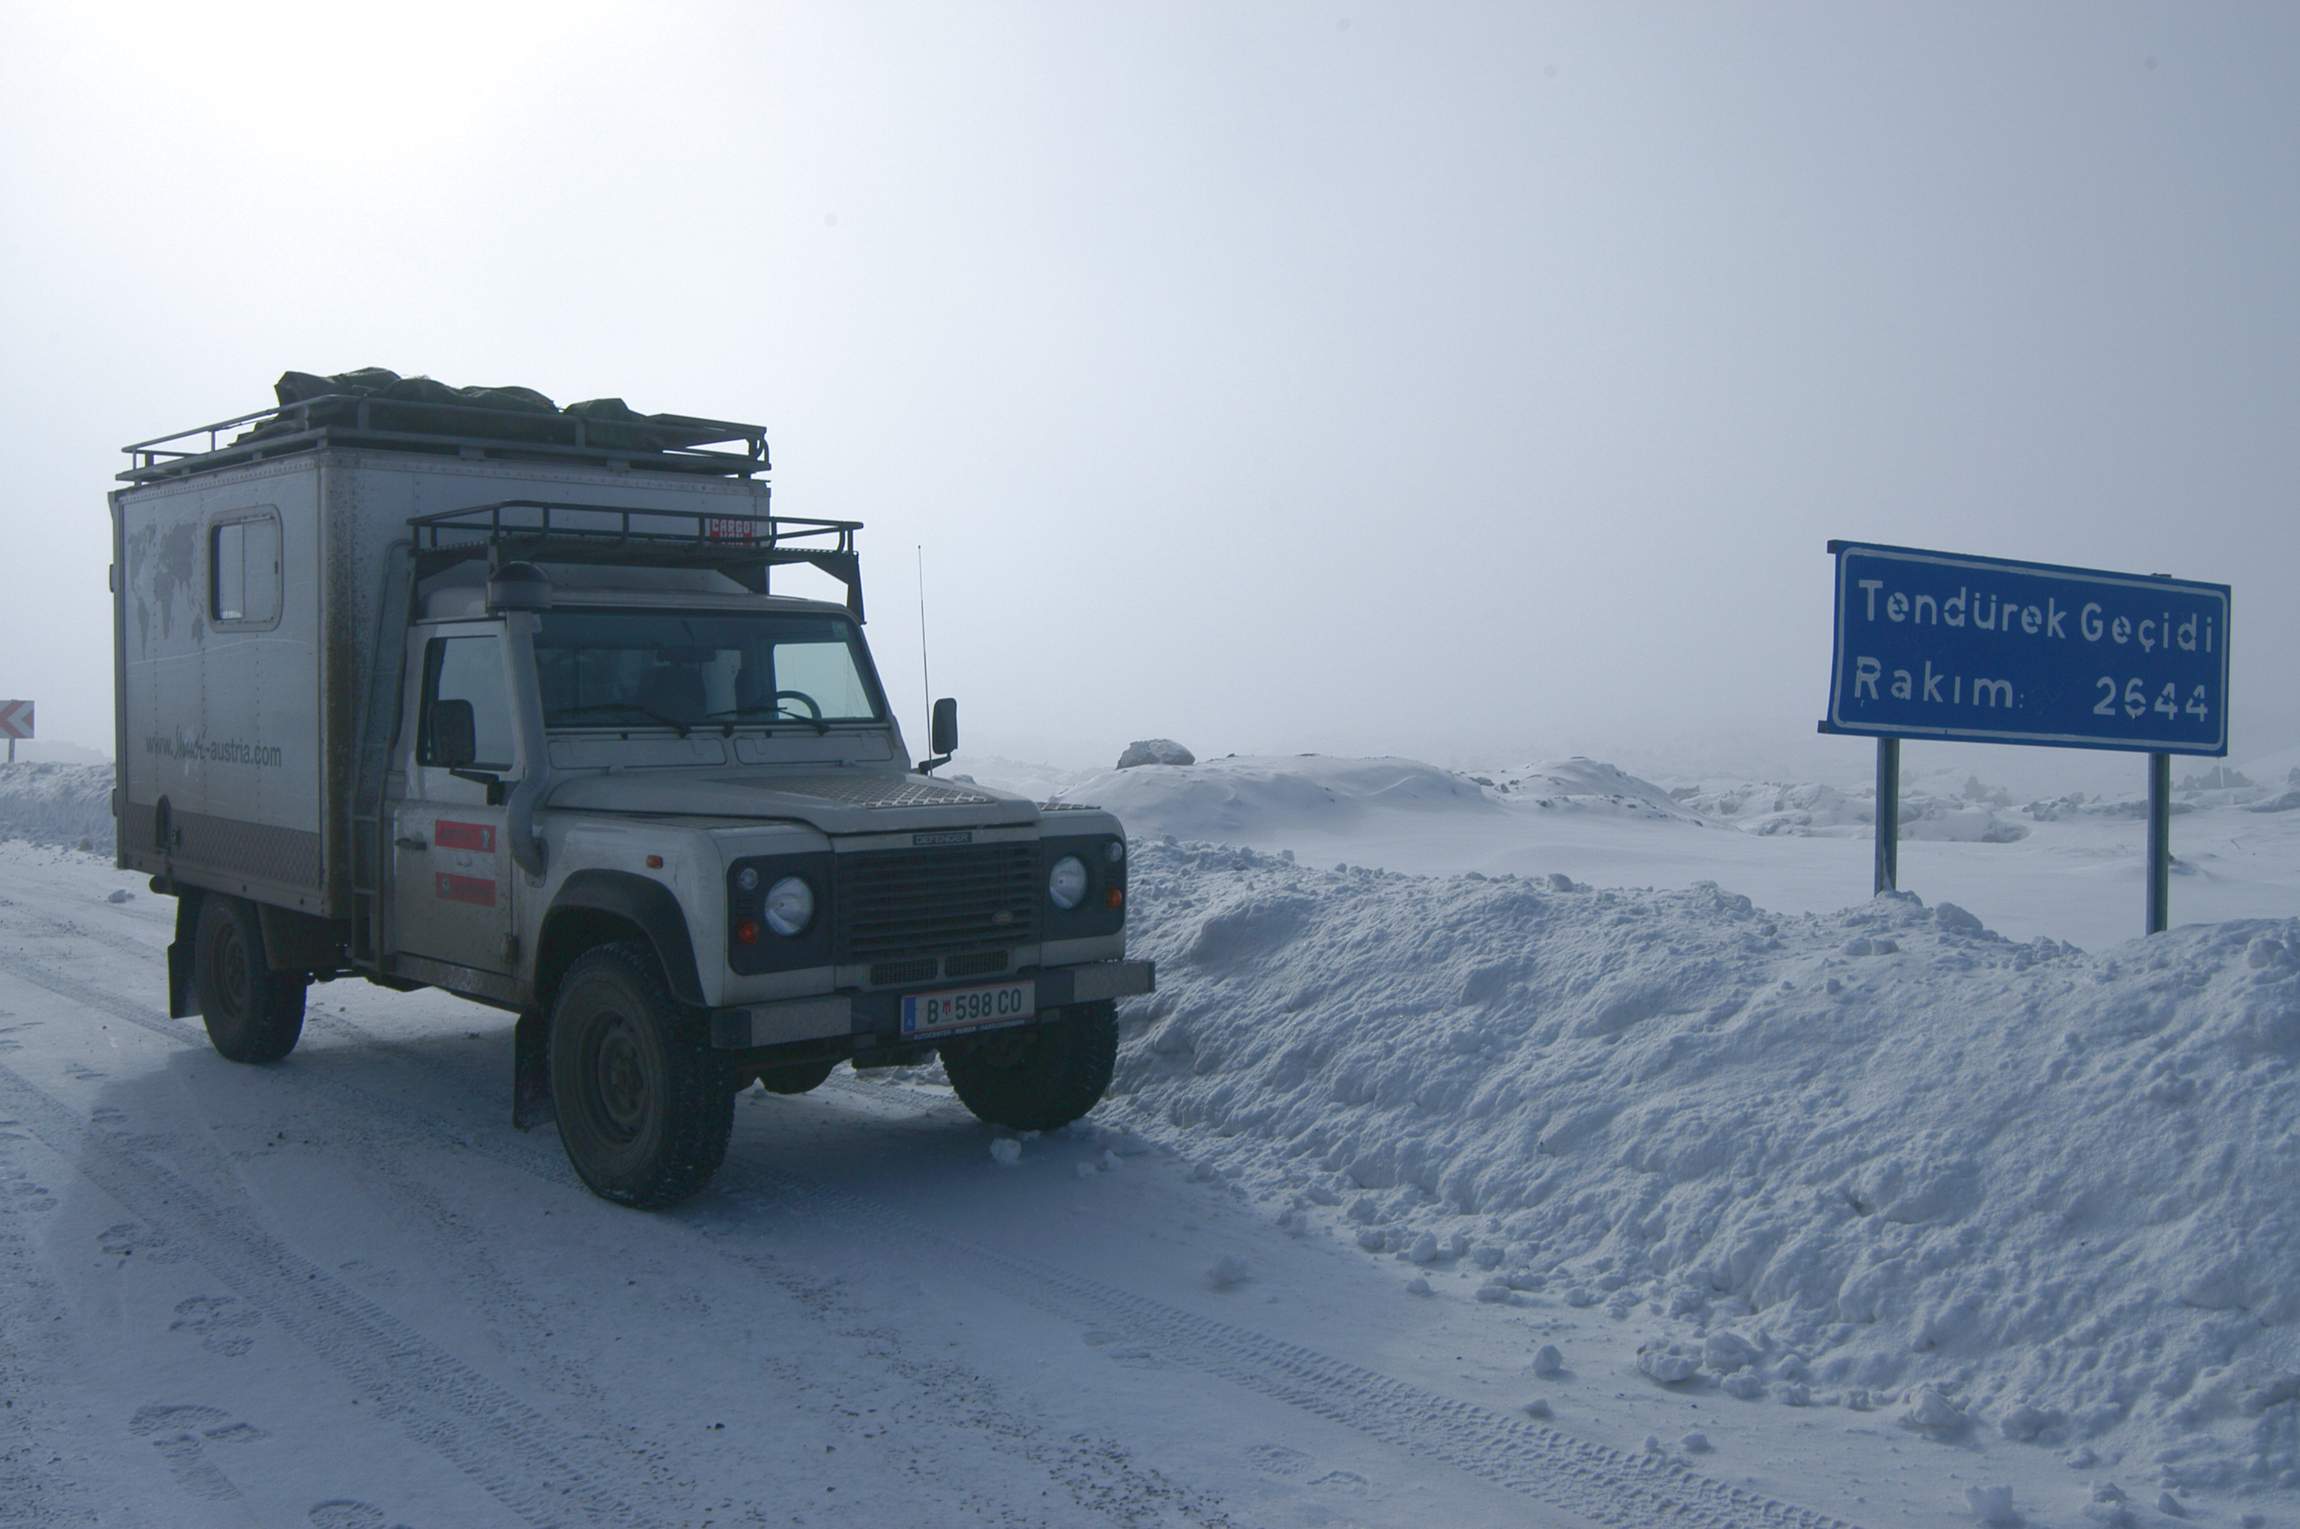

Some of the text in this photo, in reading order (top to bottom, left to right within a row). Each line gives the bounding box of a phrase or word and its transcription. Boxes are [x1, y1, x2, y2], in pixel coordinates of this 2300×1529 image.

[711, 518, 751, 534] CARGO
[1857, 580, 2213, 654] Tendürek Geçidi
[2092, 675, 2209, 722] 2644
[915, 832, 969, 845] DEFENDER
[927, 999, 939, 1024] B
[955, 992, 993, 1020] 598
